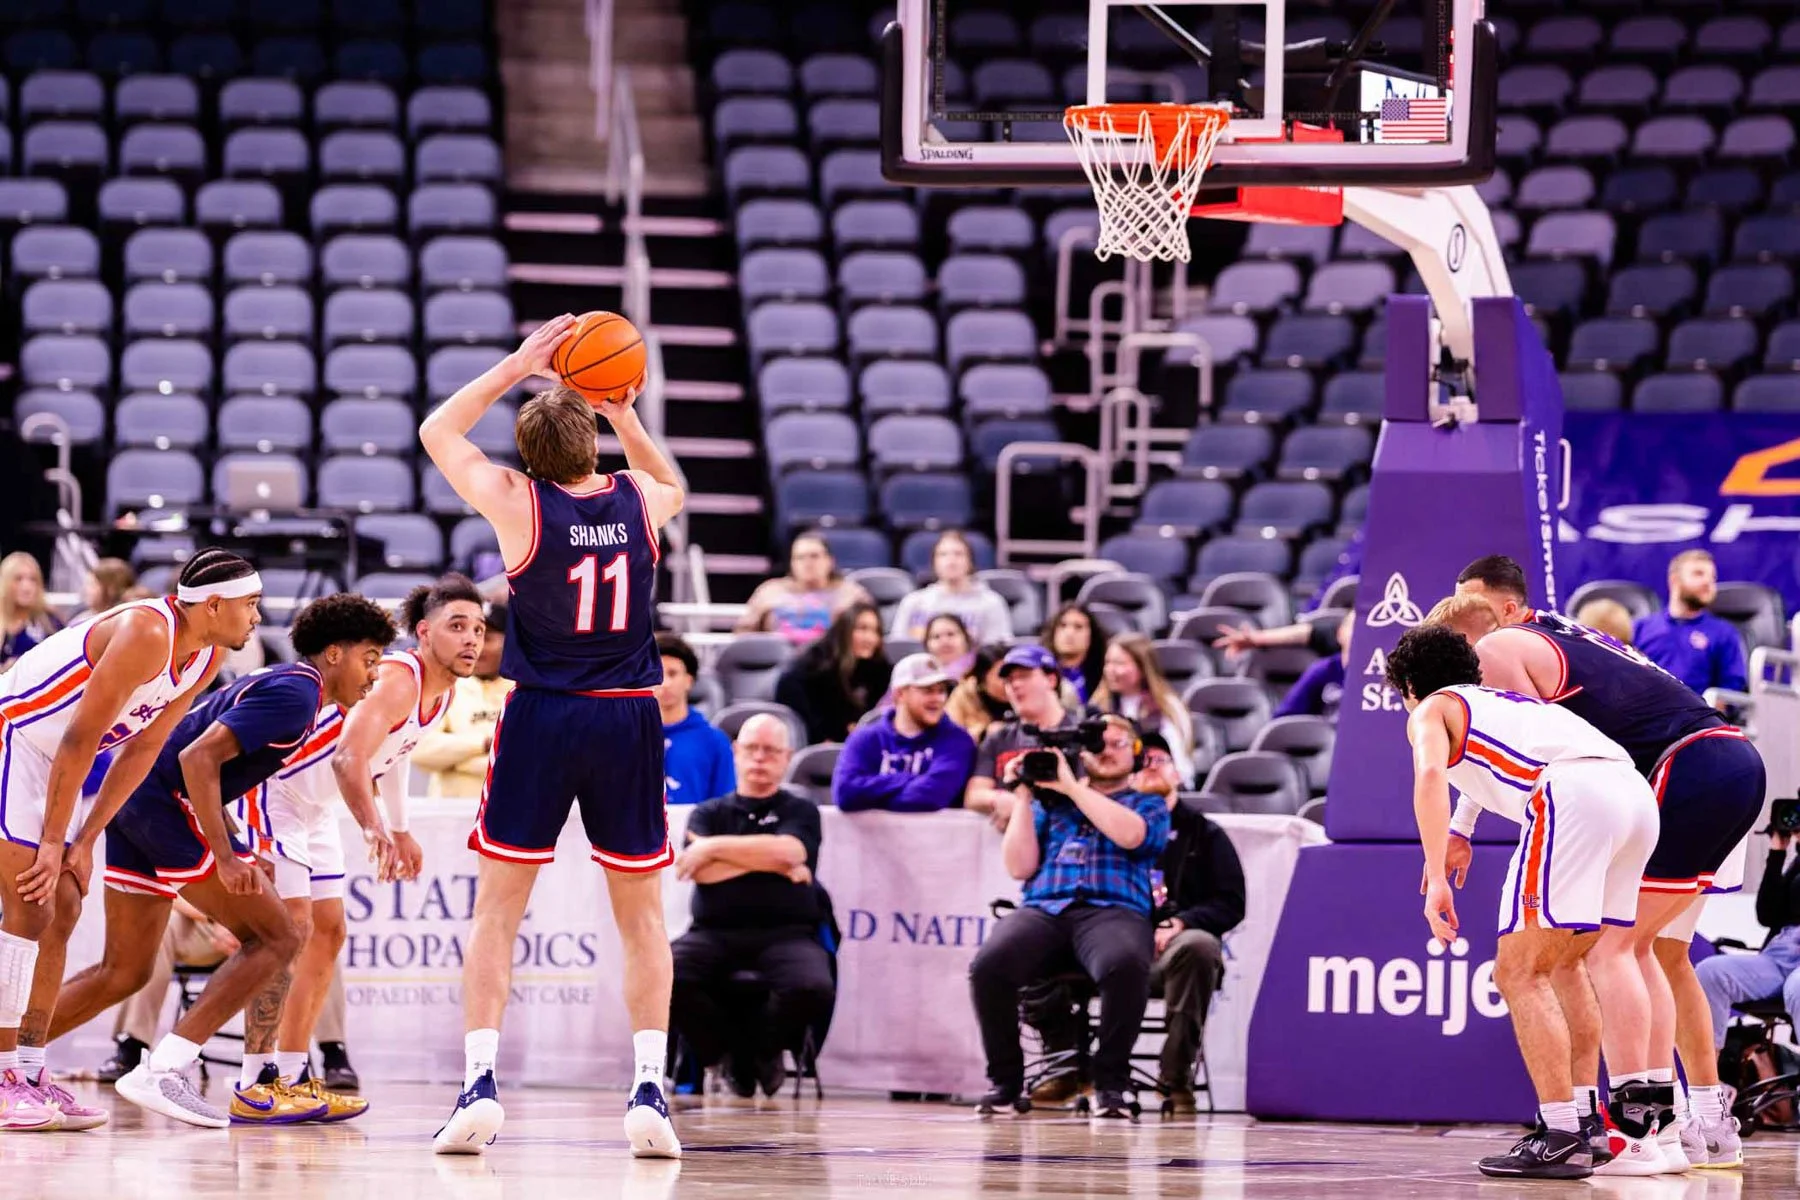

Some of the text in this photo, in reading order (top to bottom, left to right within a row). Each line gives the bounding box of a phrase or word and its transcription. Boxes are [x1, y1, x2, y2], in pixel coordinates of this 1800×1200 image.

[920, 148, 974, 160] SPALDING
[570, 522, 628, 546] SHANKS
[1534, 429, 1558, 614] TicketSmar
[567, 552, 631, 635] 11
[1362, 682, 1402, 711] St.
[346, 874, 532, 922] STAT
[891, 911, 988, 946] NATI
[346, 932, 598, 968] HOPADICS
[1306, 937, 1509, 1036] meije
